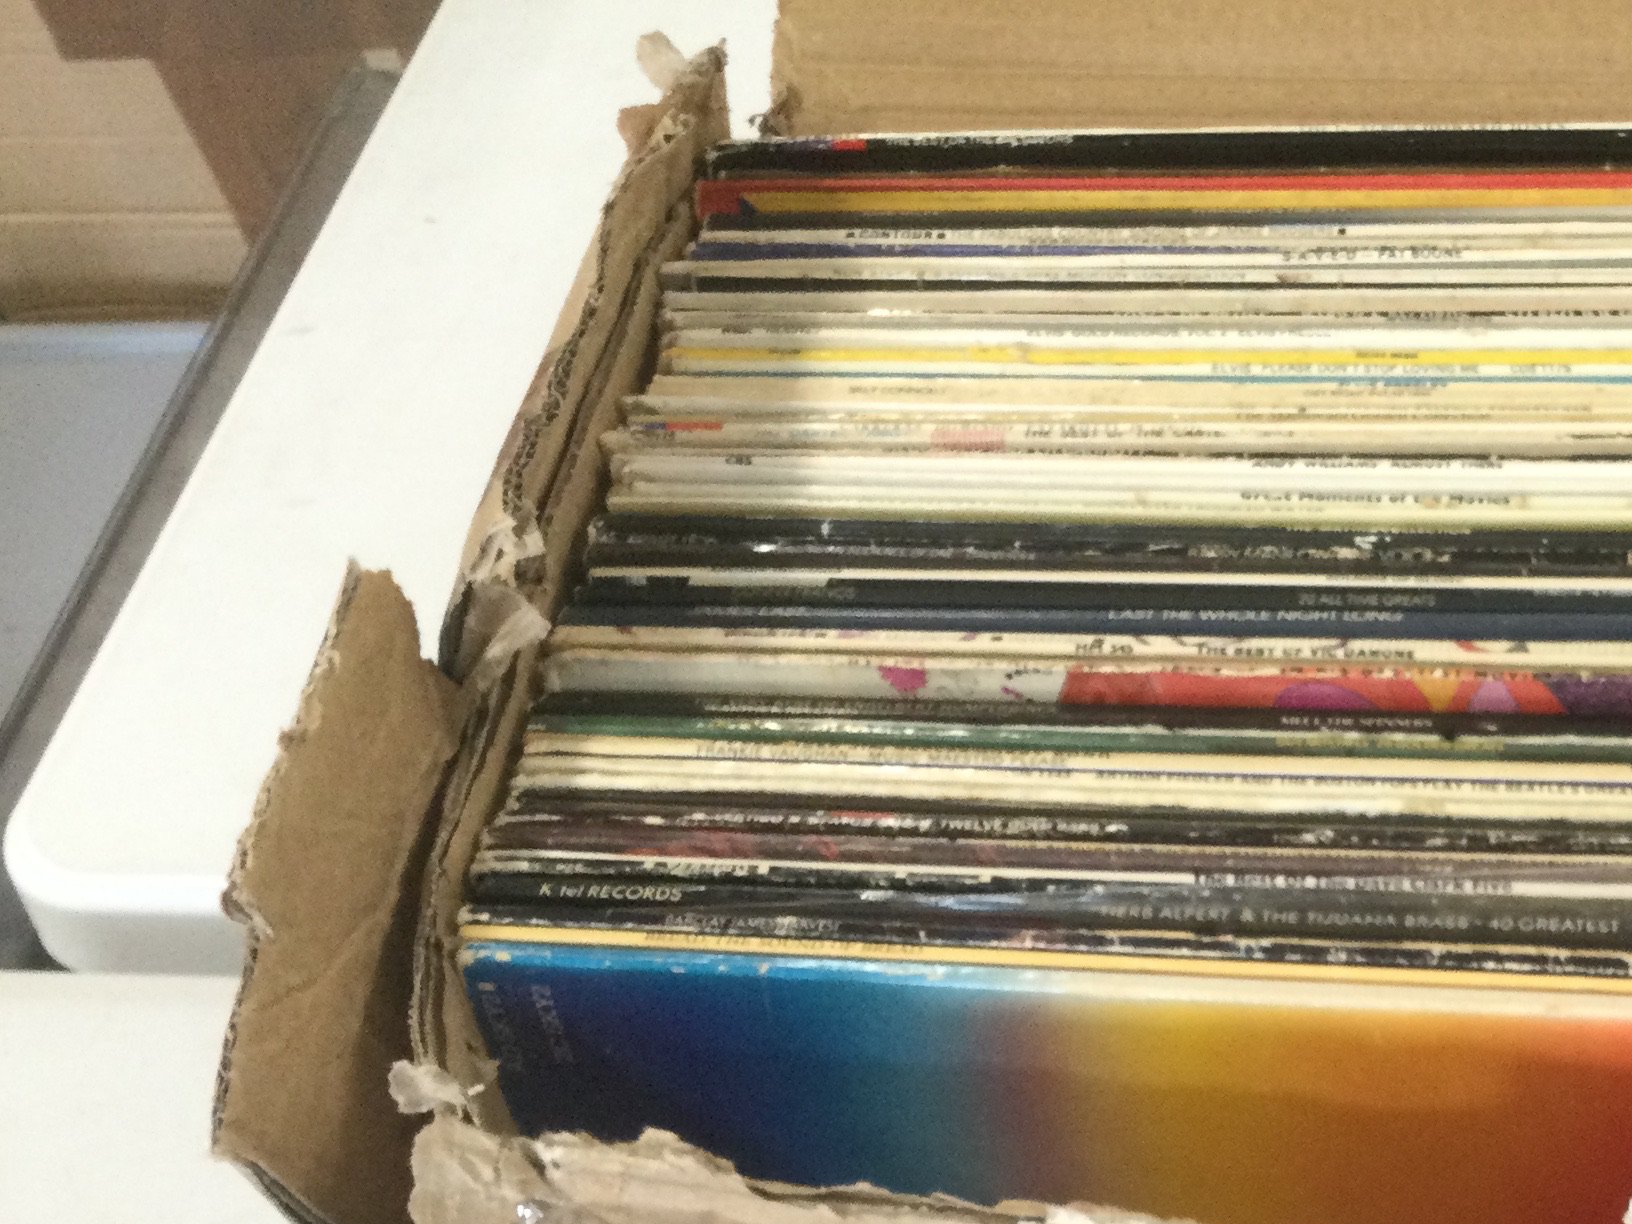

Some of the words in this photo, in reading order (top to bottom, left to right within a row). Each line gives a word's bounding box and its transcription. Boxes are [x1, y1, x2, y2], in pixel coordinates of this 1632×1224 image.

[586, 885, 683, 902] RECORDS
[1159, 905, 1232, 922] ALPERT
[1261, 908, 1299, 924] THE
[1402, 913, 1471, 929] BRASS
[1516, 917, 1620, 933] GREATEST
